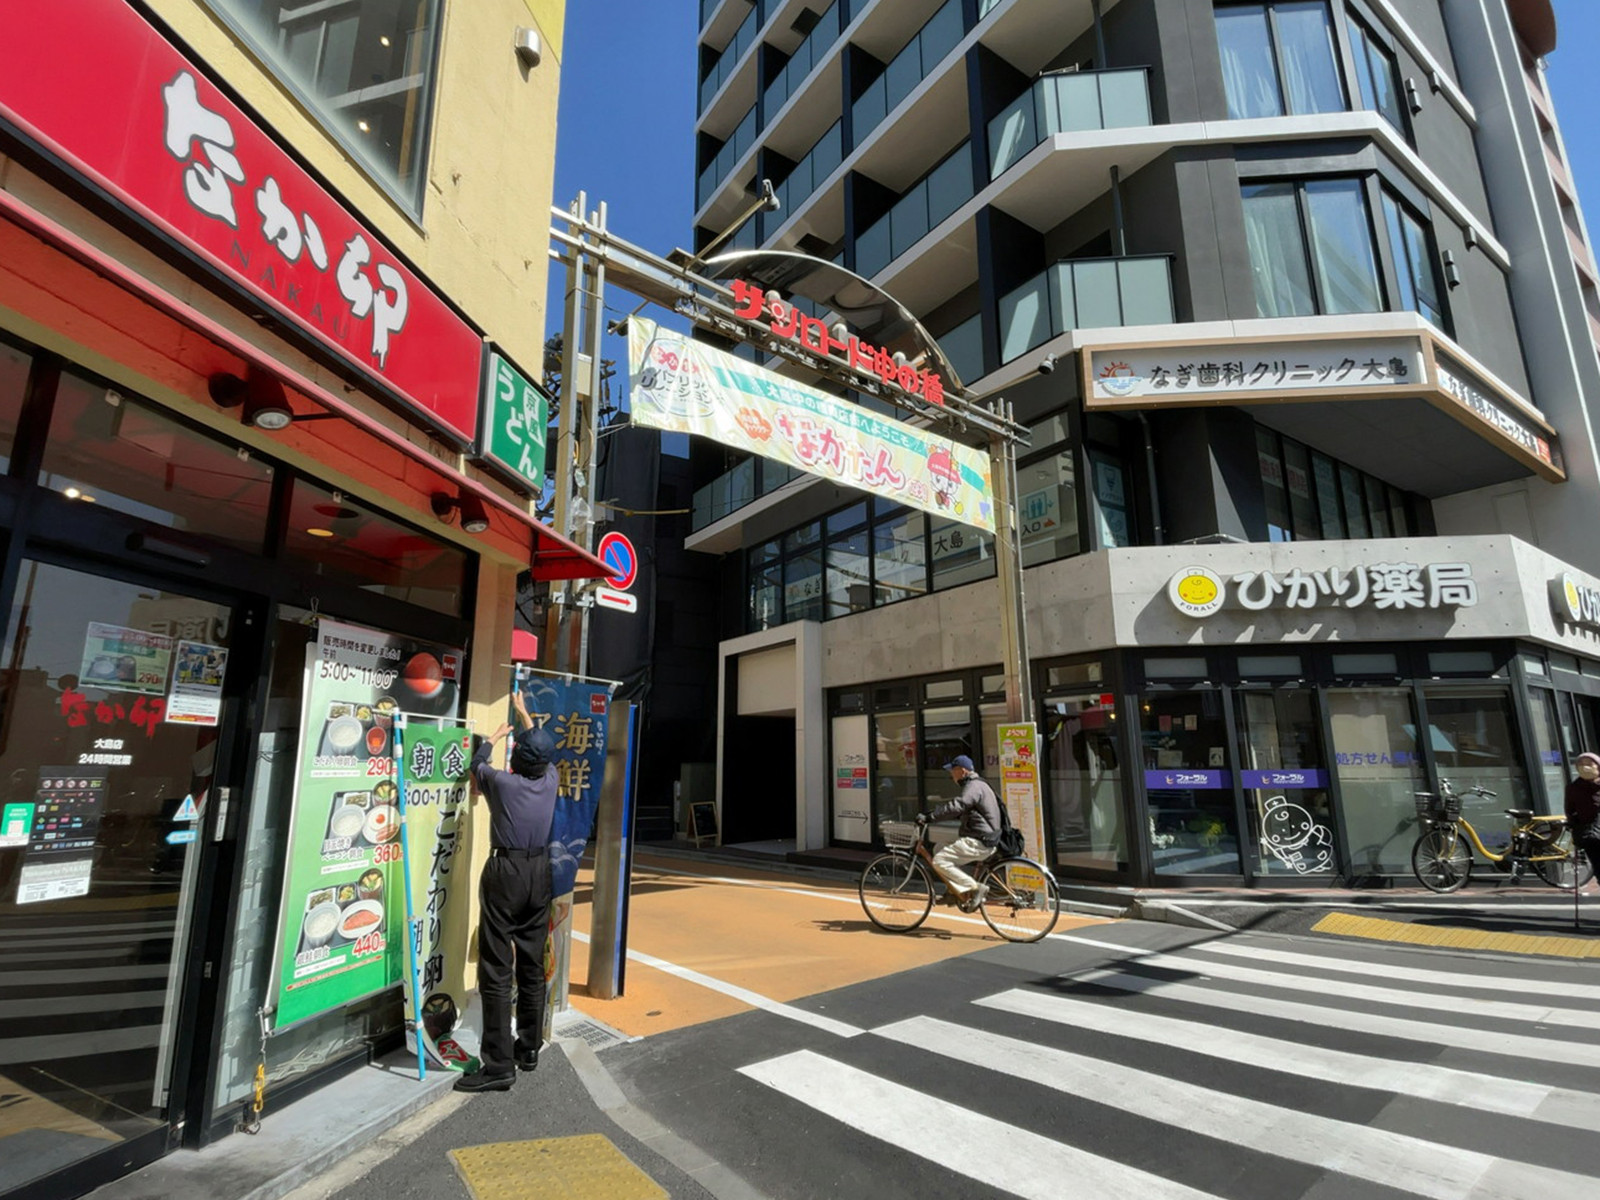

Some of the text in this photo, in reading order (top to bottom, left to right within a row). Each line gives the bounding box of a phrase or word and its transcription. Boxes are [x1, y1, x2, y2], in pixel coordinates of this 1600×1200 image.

[162, 69, 409, 369] なか卯
[230, 239, 349, 339] NAKAU
[1151, 356, 1408, 388] なぎ歯科クリニック大島
[498, 364, 538, 480] うどん
[776, 410, 907, 490] なかたん
[1021, 521, 1042, 537] 入口
[1180, 601, 1218, 611] FORALL
[1232, 562, 1478, 611] ひかり薬局
[60, 687, 166, 737] なか卯
[409, 742, 466, 779] 朝食
[555, 711, 594, 802] 海鮮
[422, 810, 457, 996] こだわり卵
